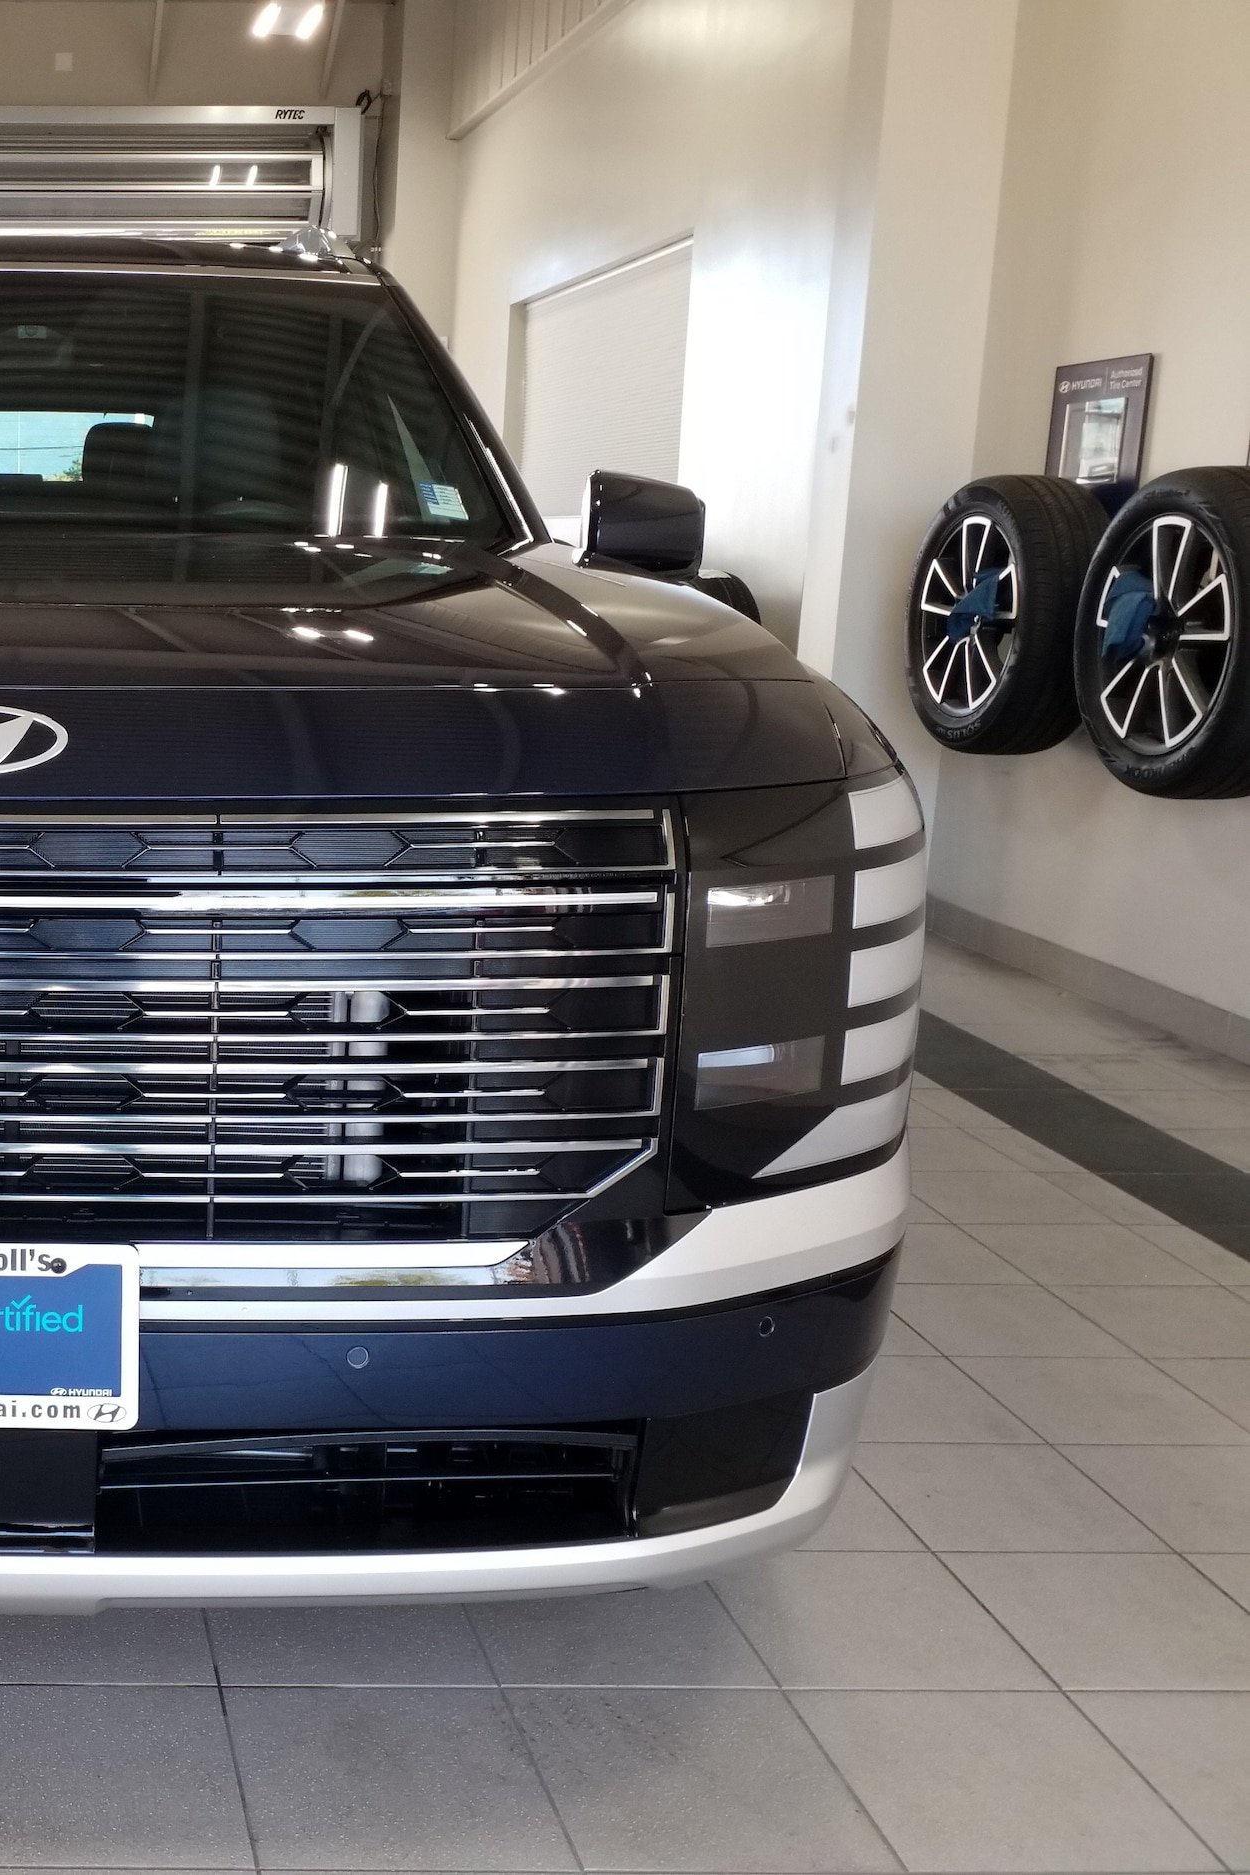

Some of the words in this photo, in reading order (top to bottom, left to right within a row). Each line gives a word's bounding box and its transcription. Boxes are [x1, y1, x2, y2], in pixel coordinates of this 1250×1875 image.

[275, 109, 305, 119] RYTEC
[1071, 378, 1103, 390] HYUNDAI
[1121, 379, 1142, 389] Center
[68, 1388, 112, 1397] HYUNDAI
